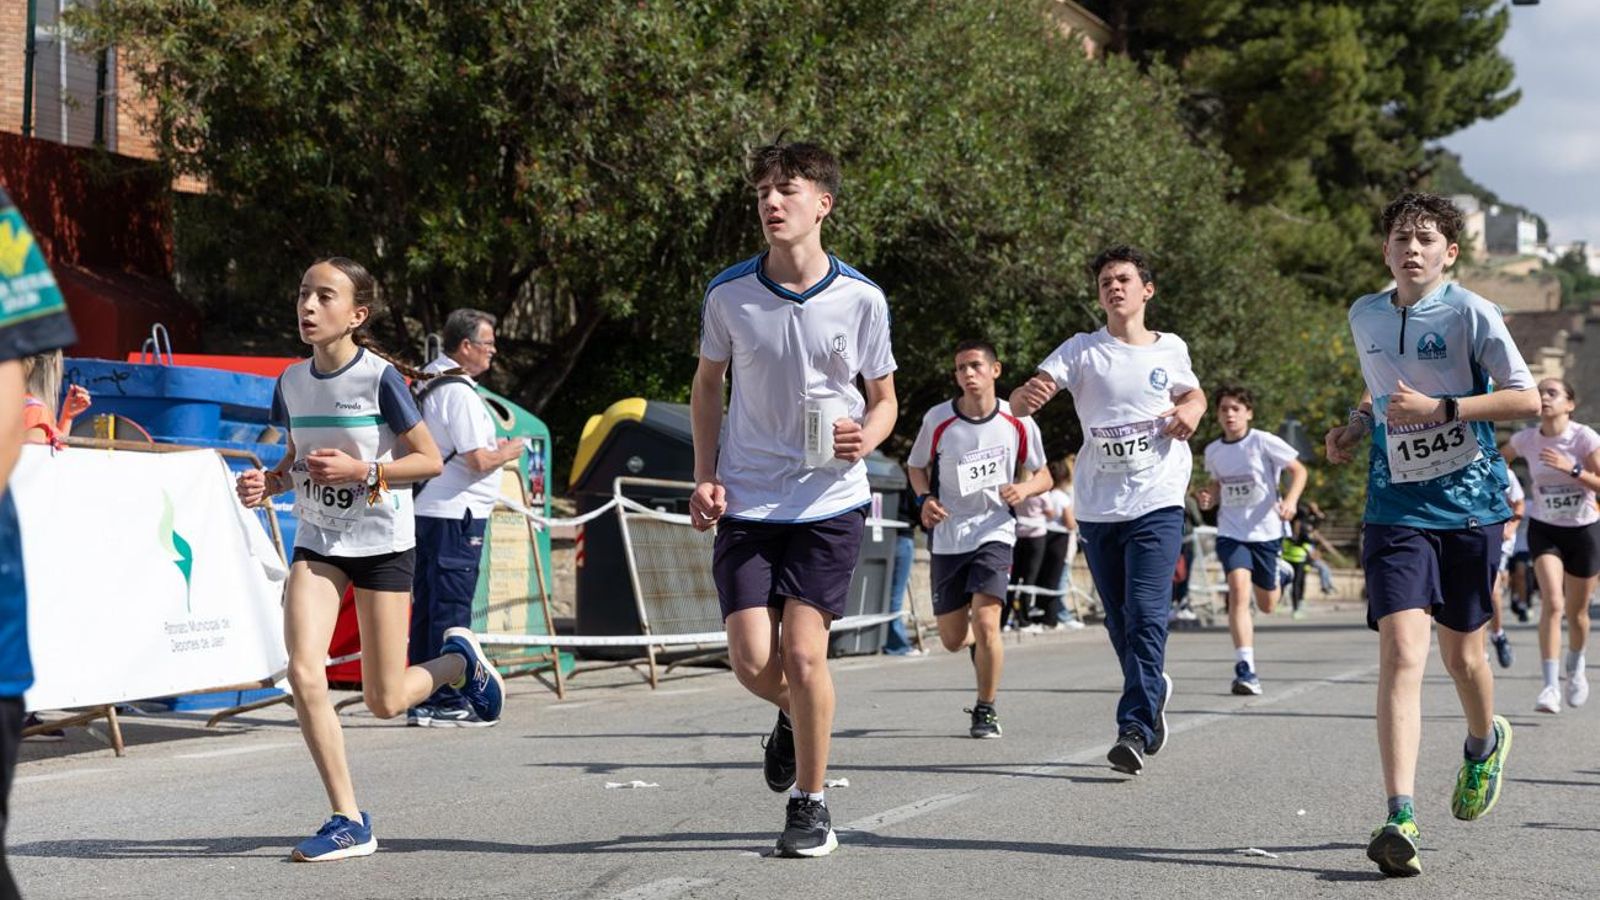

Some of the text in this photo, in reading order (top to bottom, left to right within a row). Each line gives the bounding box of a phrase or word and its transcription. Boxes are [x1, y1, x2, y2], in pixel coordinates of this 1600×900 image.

[1102, 435, 1149, 457] 1075
[1397, 426, 1465, 461] 1543
[970, 461, 997, 480] 312
[303, 478, 353, 510] 1069
[1227, 485, 1250, 496] 715
[1545, 494, 1581, 509] 1547
